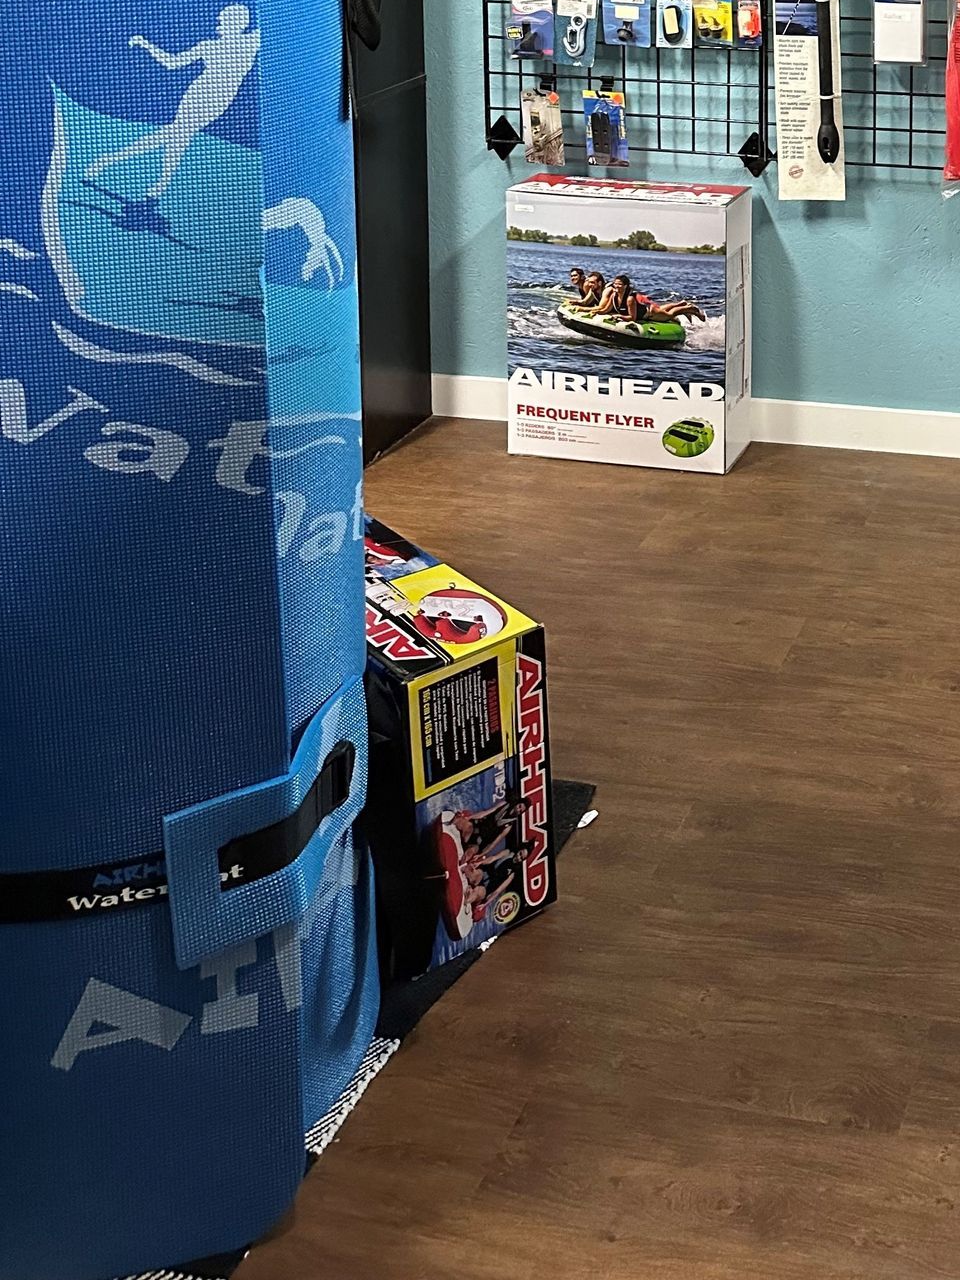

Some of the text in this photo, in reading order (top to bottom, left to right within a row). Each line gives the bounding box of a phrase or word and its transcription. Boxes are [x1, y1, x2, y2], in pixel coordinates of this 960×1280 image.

[507, 367, 725, 401] AIRHEAD
[517, 404, 655, 428] FREQUENT FLYER
[422, 688, 431, 702] 165
[423, 703, 431, 715] cm
[424, 720, 432, 735] 165
[425, 735, 433, 747] cm
[516, 652, 549, 907] AIRHEAD
